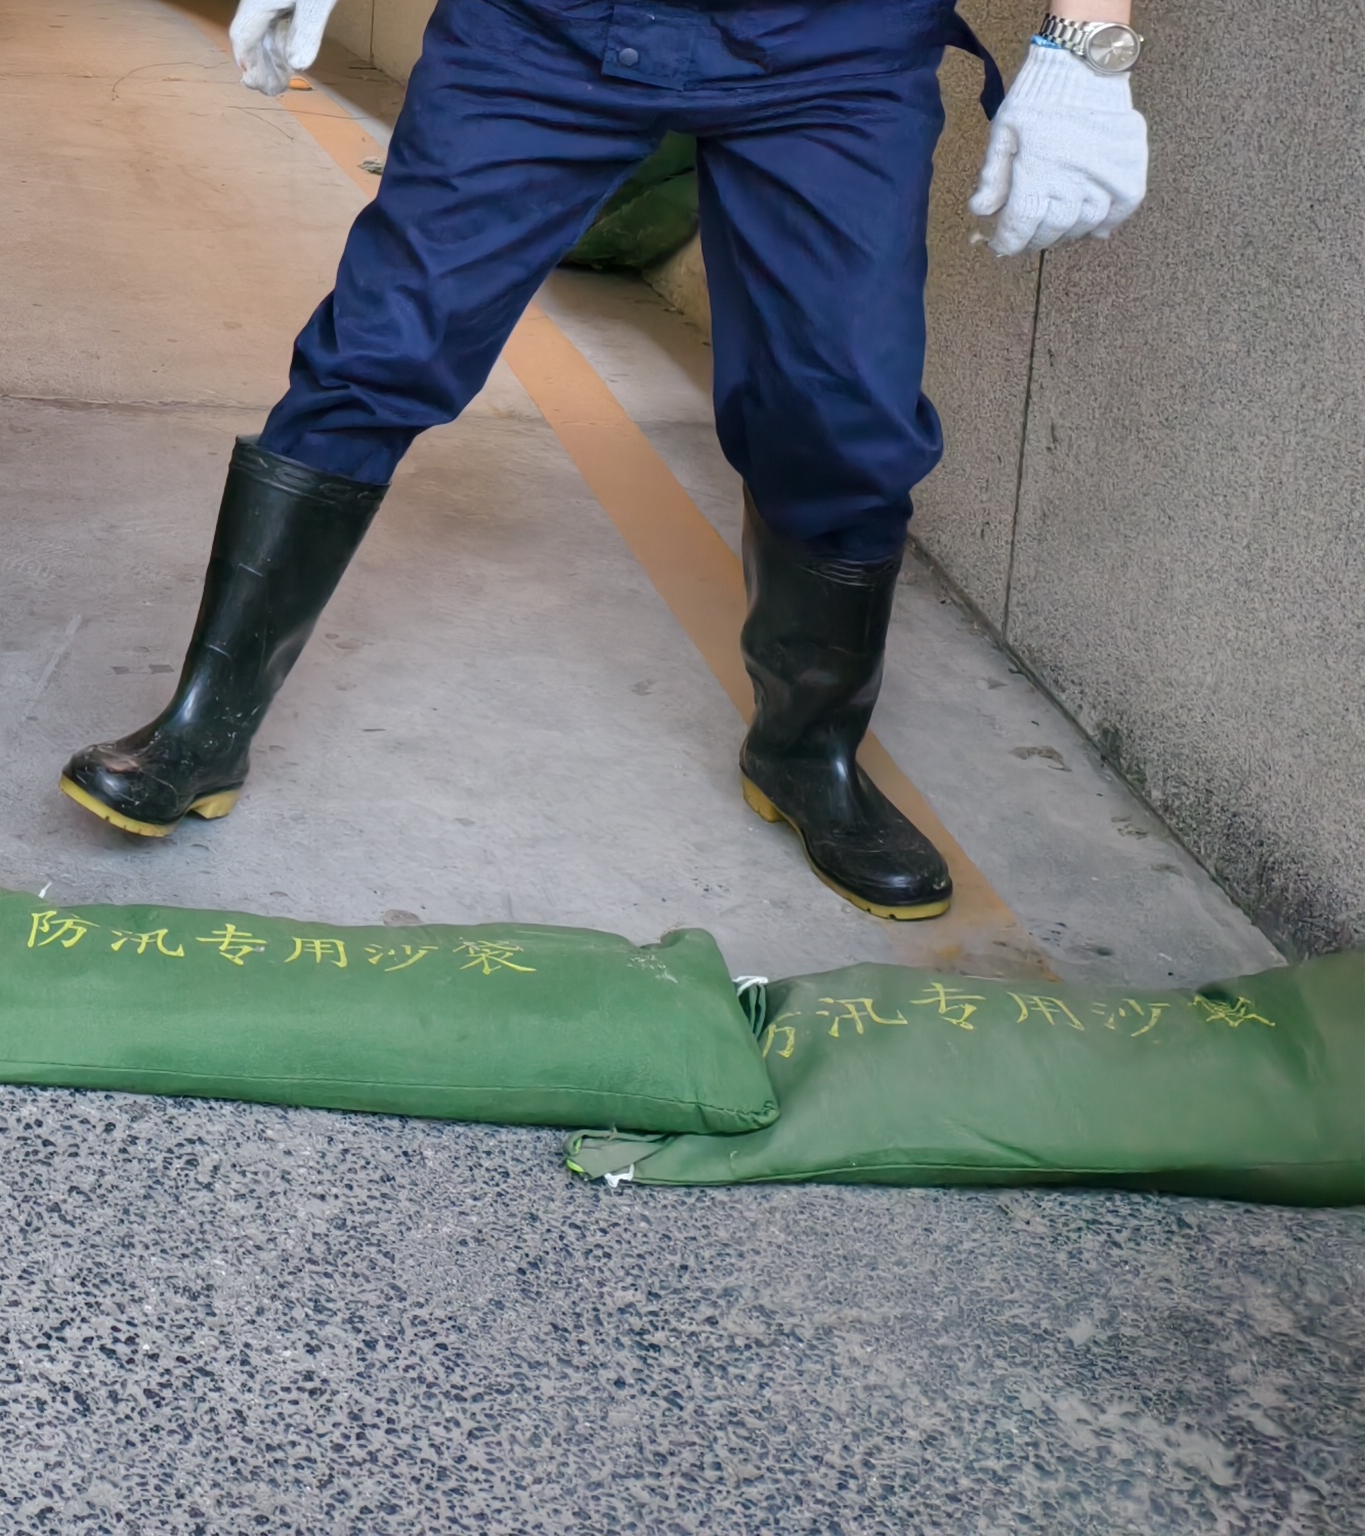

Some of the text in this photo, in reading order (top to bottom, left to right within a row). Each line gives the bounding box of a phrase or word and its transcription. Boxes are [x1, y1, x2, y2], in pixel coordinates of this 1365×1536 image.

[26, 910, 536, 975] 防汛专用沙袋
